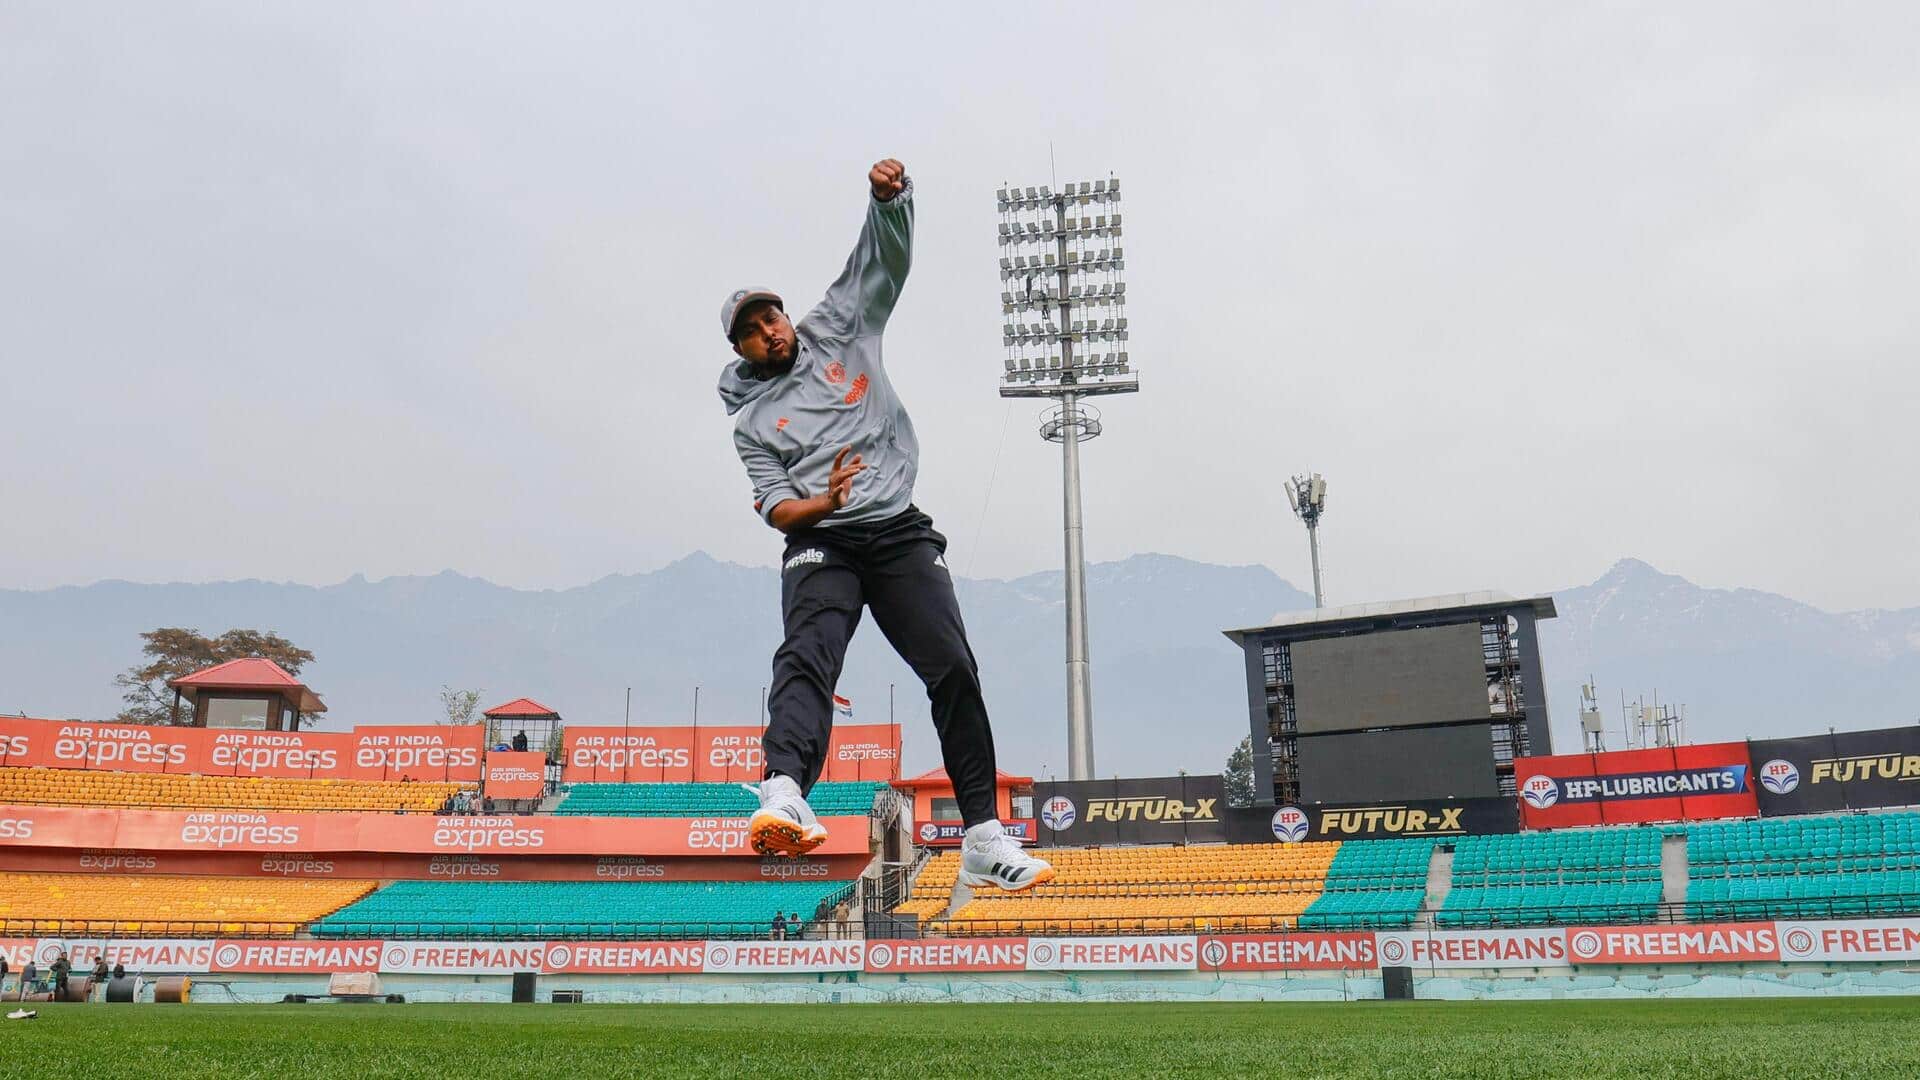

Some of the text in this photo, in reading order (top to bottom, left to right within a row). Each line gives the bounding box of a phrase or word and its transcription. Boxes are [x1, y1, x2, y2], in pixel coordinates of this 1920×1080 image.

[59, 726, 152, 741] AIR INDIA
[215, 734, 303, 746] AIR INDIA
[359, 735, 443, 746] AIR INDIA
[575, 736, 656, 746] AIR INDIA
[711, 736, 741, 746] AIR
[55, 738, 187, 766] express
[212, 745, 337, 772] express
[356, 747, 477, 772] express
[838, 748, 896, 762] express
[573, 748, 689, 772] express
[1769, 764, 1789, 775] HP
[490, 772, 540, 783] express
[1531, 780, 1550, 791] HP
[1051, 802, 1069, 812] HP
[1086, 799, 1217, 822] FUTUR-X
[185, 814, 267, 824] AIR INDIA
[437, 818, 513, 827] AIR INDIA
[690, 820, 749, 829] AIR IND
[1280, 813, 1300, 823] HP
[1319, 807, 1464, 834] FUTUR-X
[181, 825, 299, 848] express
[433, 829, 545, 850] express
[941, 827, 957, 837] HP
[688, 830, 749, 853] expr
[80, 855, 157, 870] express
[261, 860, 335, 875] express
[429, 863, 500, 877] express
[596, 864, 665, 879] express
[760, 864, 829, 879] express
[1412, 936, 1565, 961] FREEMANS
[1606, 929, 1776, 955] FREEMANS
[70, 943, 209, 966] FREEMANS
[244, 944, 379, 967] FREEMANS
[412, 946, 542, 968] FREEMANS
[574, 946, 702, 968] FREEMANS
[734, 944, 861, 966] FREEMANS
[897, 943, 1025, 966] FREEMANS
[1059, 941, 1194, 963] FREEMANS
[1232, 938, 1374, 963] FREEMANS
